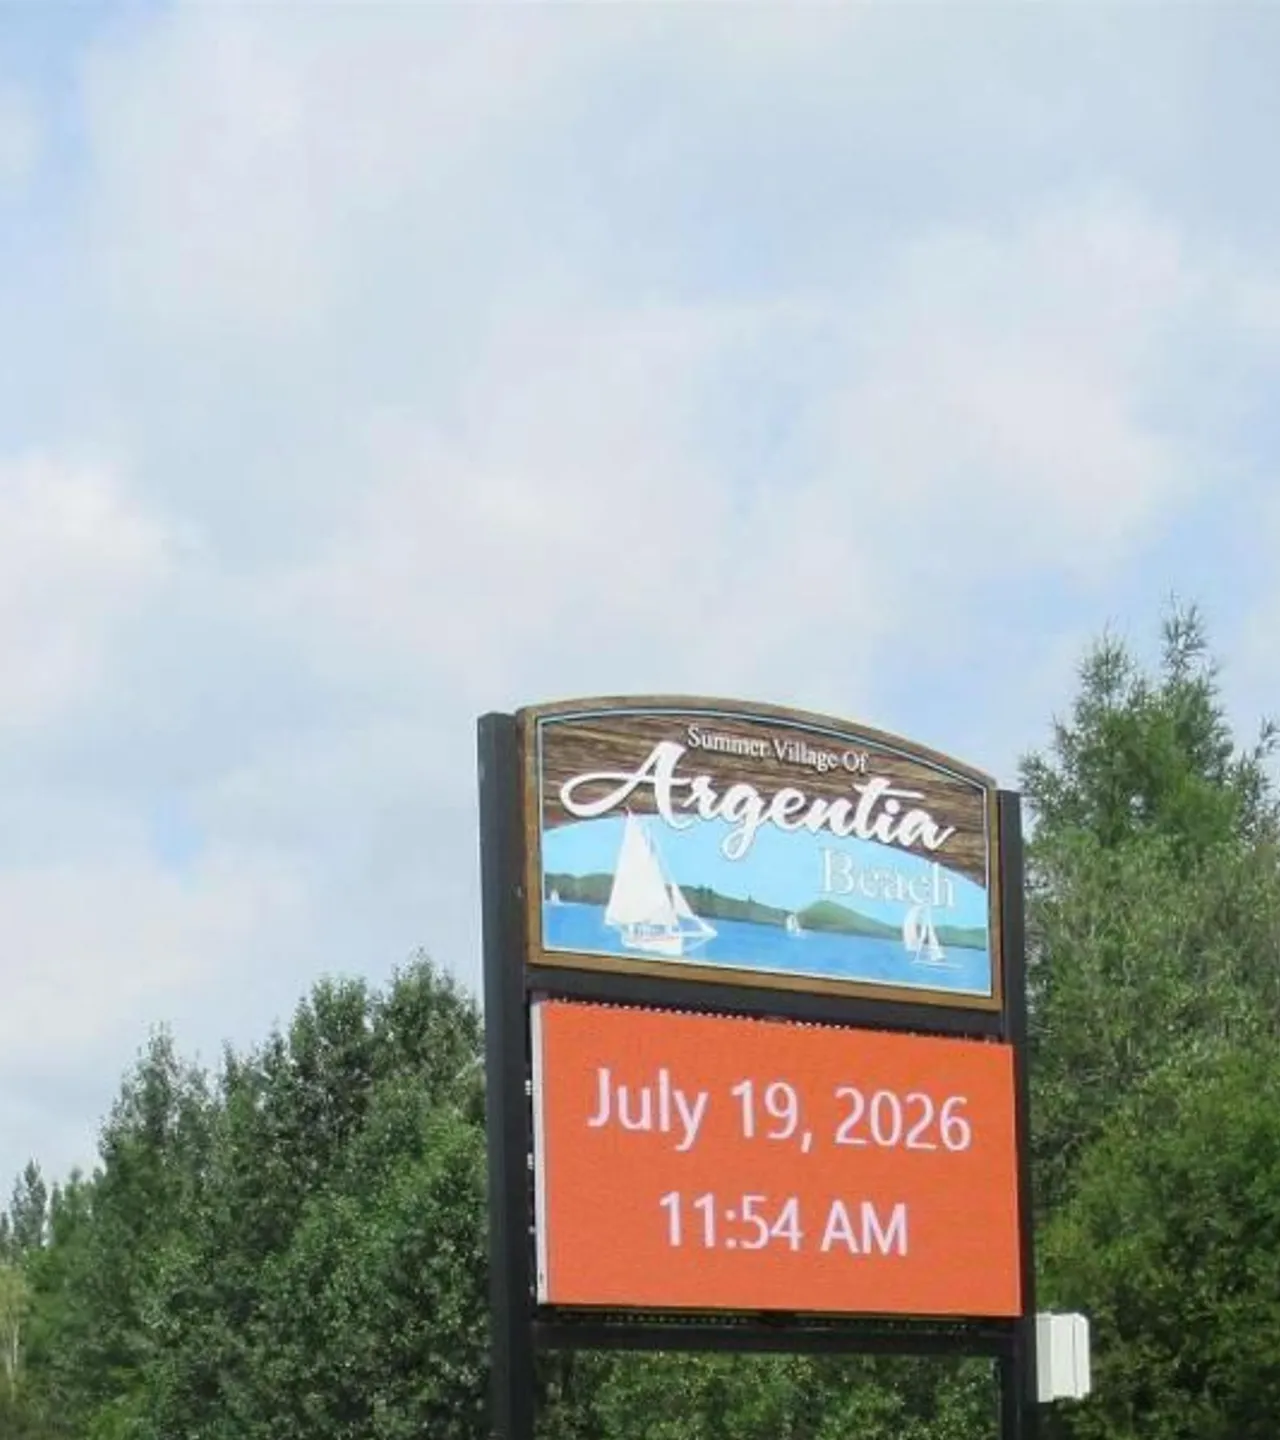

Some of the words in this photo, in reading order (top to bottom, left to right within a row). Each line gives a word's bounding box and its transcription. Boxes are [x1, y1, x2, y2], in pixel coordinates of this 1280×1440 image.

[688, 723, 768, 757] Summer
[772, 738, 837, 770] Village
[842, 752, 870, 773] Of
[559, 741, 956, 860] Argentia
[821, 847, 955, 908] Beach
[587, 1067, 709, 1152] July
[731, 1077, 813, 1153] 19,
[833, 1086, 972, 1152] 2026
[659, 1191, 802, 1250] 11:54
[821, 1199, 908, 1257] AM
